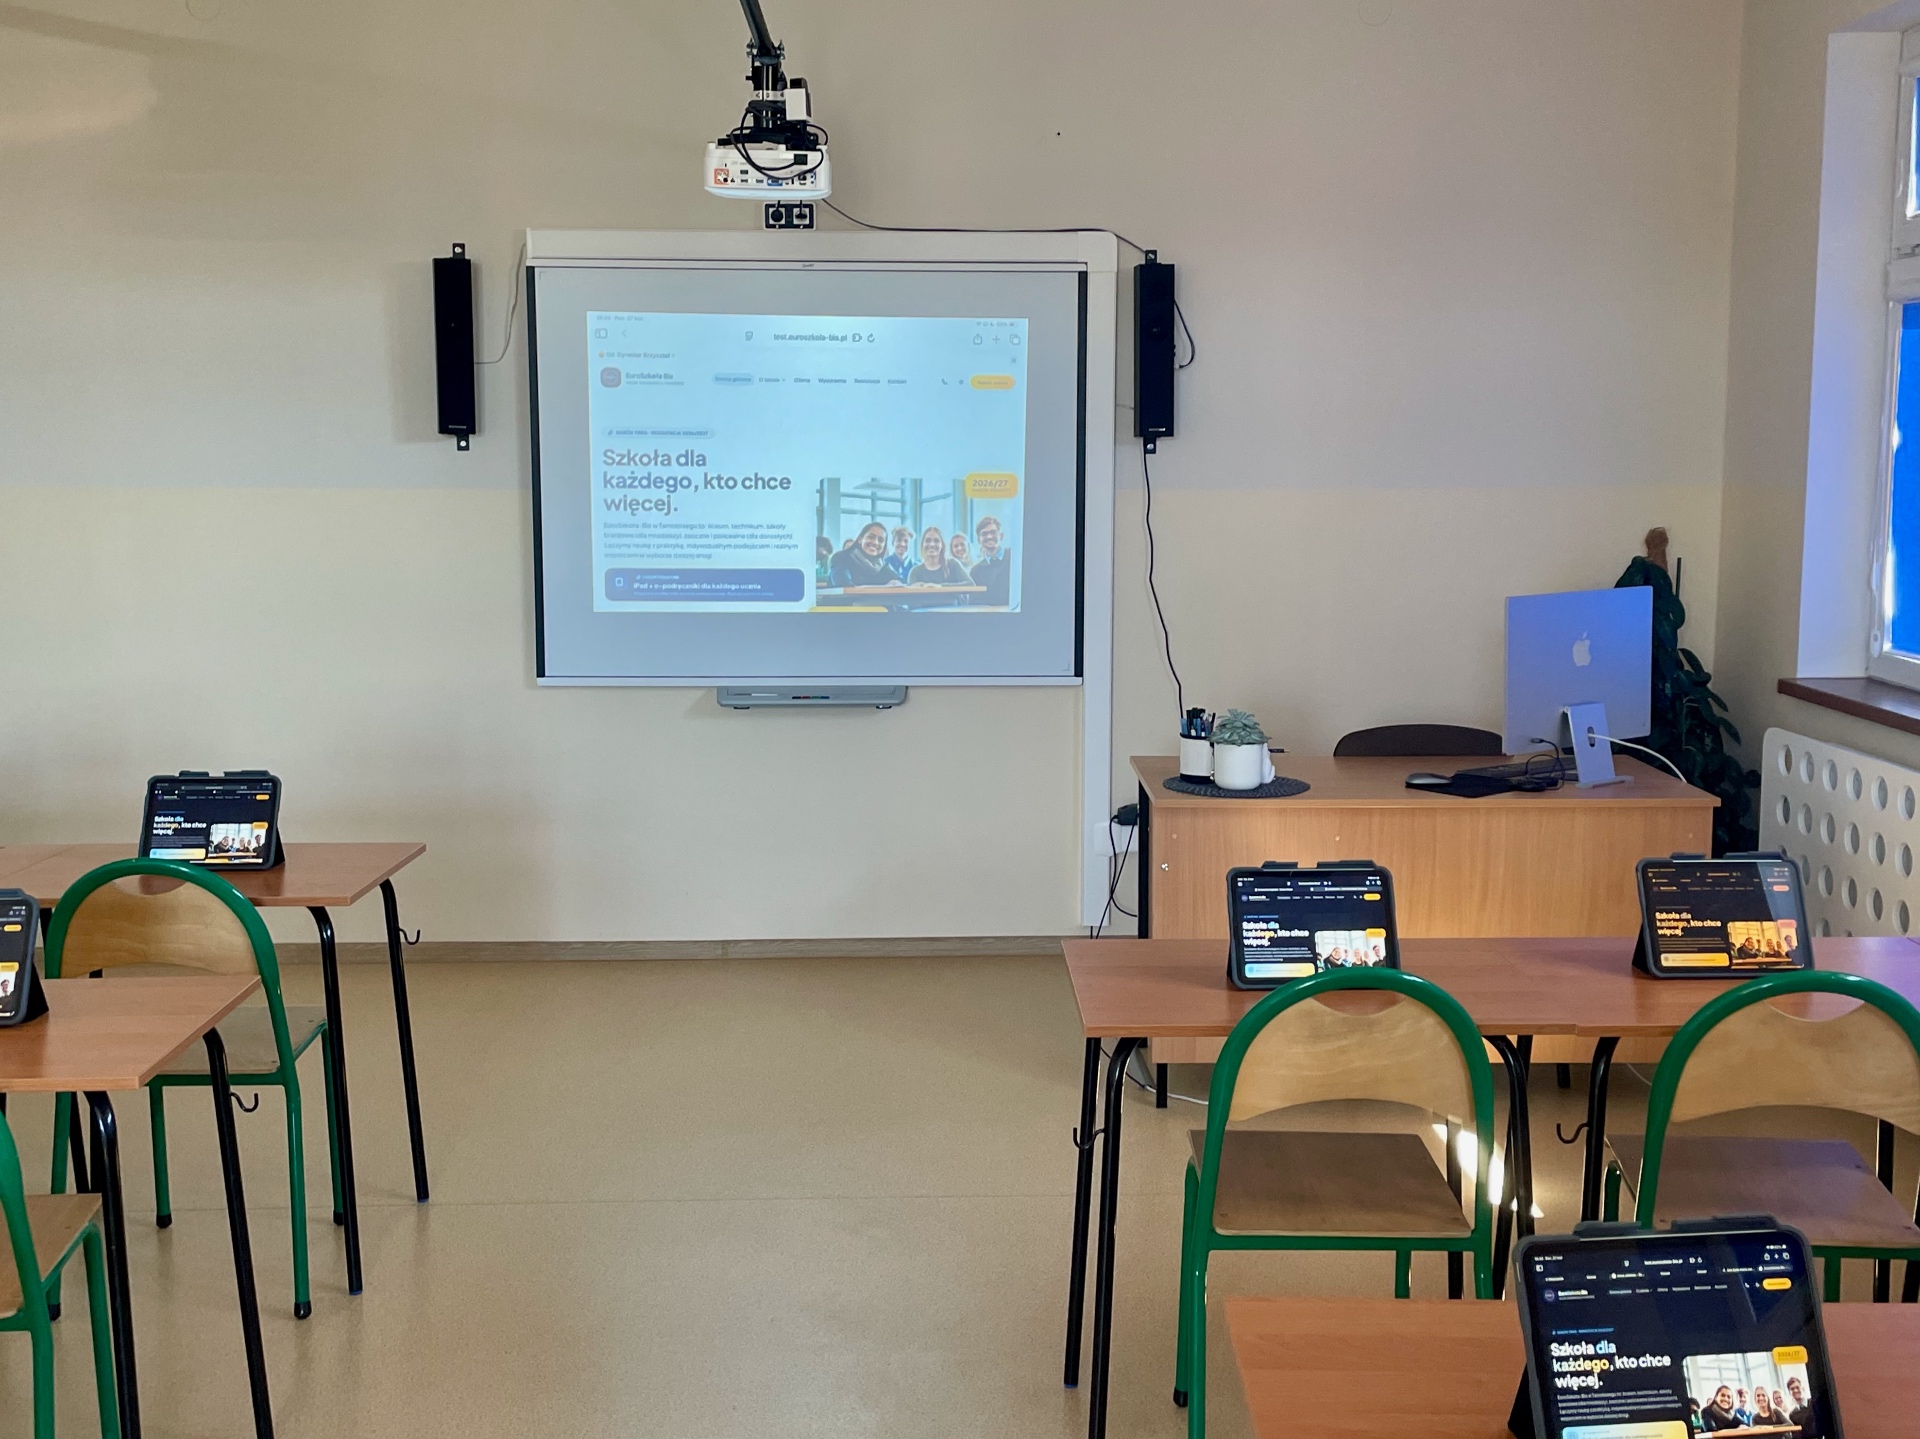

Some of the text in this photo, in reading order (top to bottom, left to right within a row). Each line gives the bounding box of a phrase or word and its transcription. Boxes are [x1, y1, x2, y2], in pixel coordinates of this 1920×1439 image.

[602, 448, 707, 467] Szkoła dla
[602, 471, 792, 494] każdego, kto chce
[972, 479, 1009, 488] 2026/27
[603, 494, 678, 516] więcej.
[1550, 1339, 1617, 1357] Szkoła dla
[1552, 1353, 1672, 1374] każdego, kto chce
[1554, 1372, 1604, 1391] więcej.
